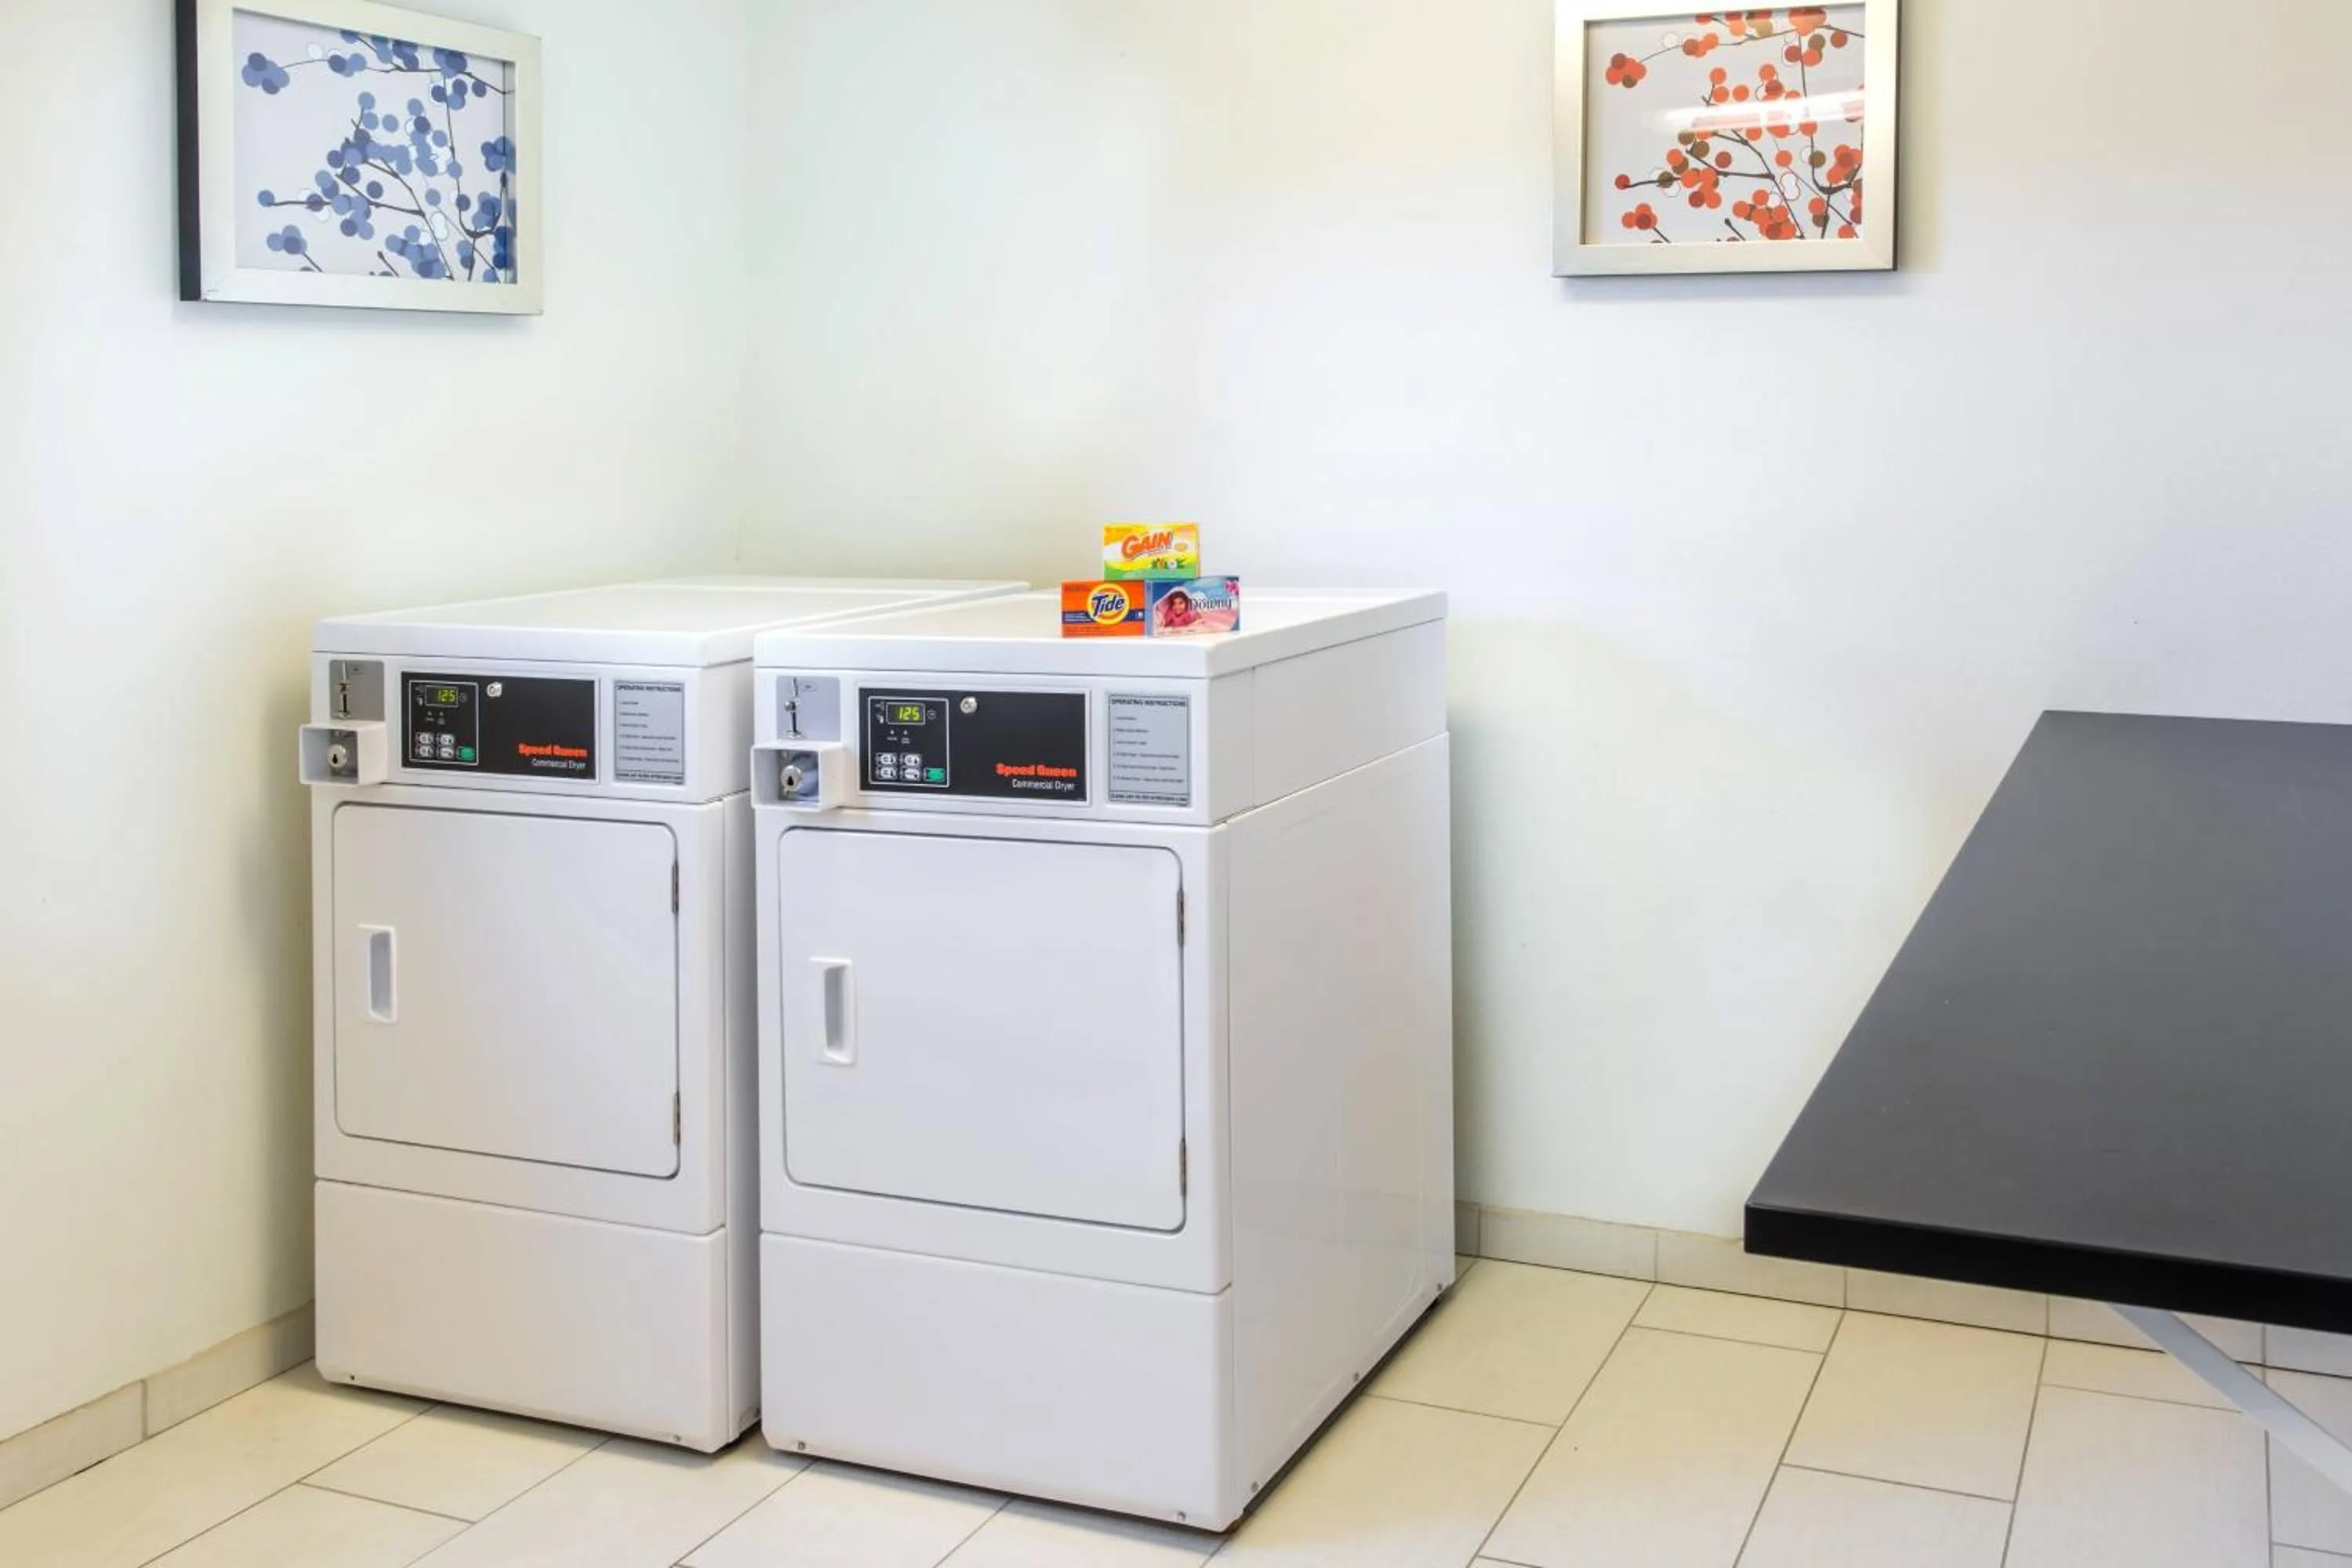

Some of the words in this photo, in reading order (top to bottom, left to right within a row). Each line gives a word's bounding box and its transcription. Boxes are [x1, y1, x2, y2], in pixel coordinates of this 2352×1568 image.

[1091, 593, 1125, 617] Tide
[1188, 597, 1232, 610] Downy
[438, 689, 456, 702] 125
[899, 706, 920, 720] 125
[518, 742, 552, 757] Speed
[553, 745, 587, 758] Queen
[568, 760, 586, 771] Dryer
[996, 763, 1035, 776] Speed
[1036, 764, 1077, 778] Queen
[1012, 779, 1054, 789] Commercial
[1054, 781, 1075, 792] Dryer
